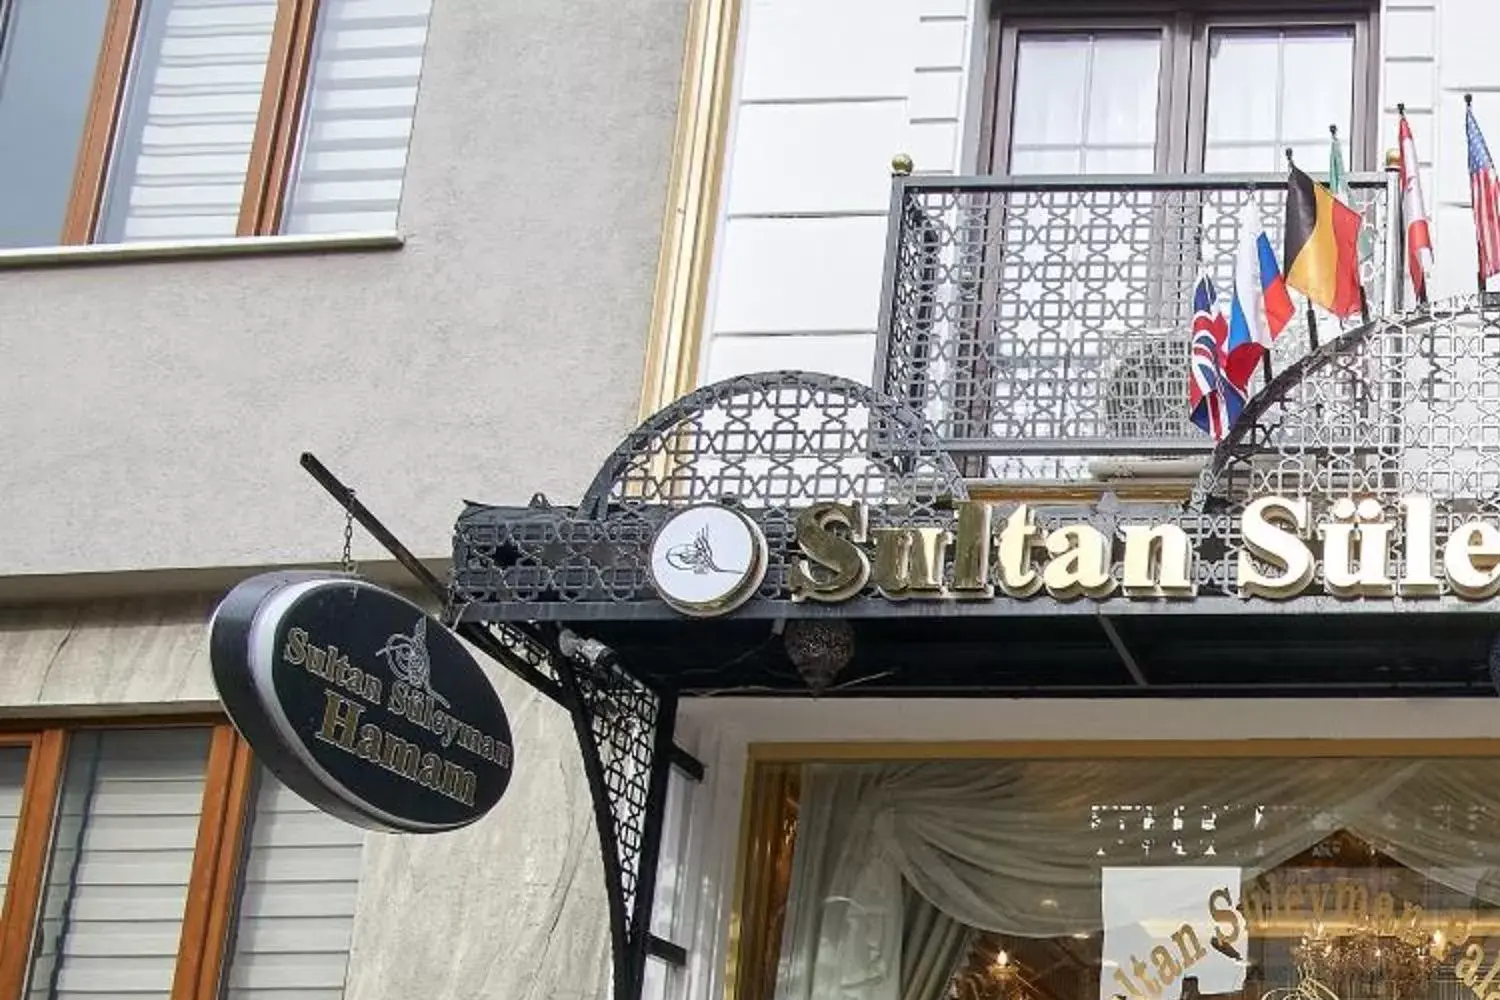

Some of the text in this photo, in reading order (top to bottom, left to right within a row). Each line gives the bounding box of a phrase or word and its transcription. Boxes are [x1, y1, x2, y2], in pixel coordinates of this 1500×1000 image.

[791, 500, 1199, 601] Sultan
[283, 626, 511, 769] Sultan Süleyman
[315, 688, 478, 807] Hamam
